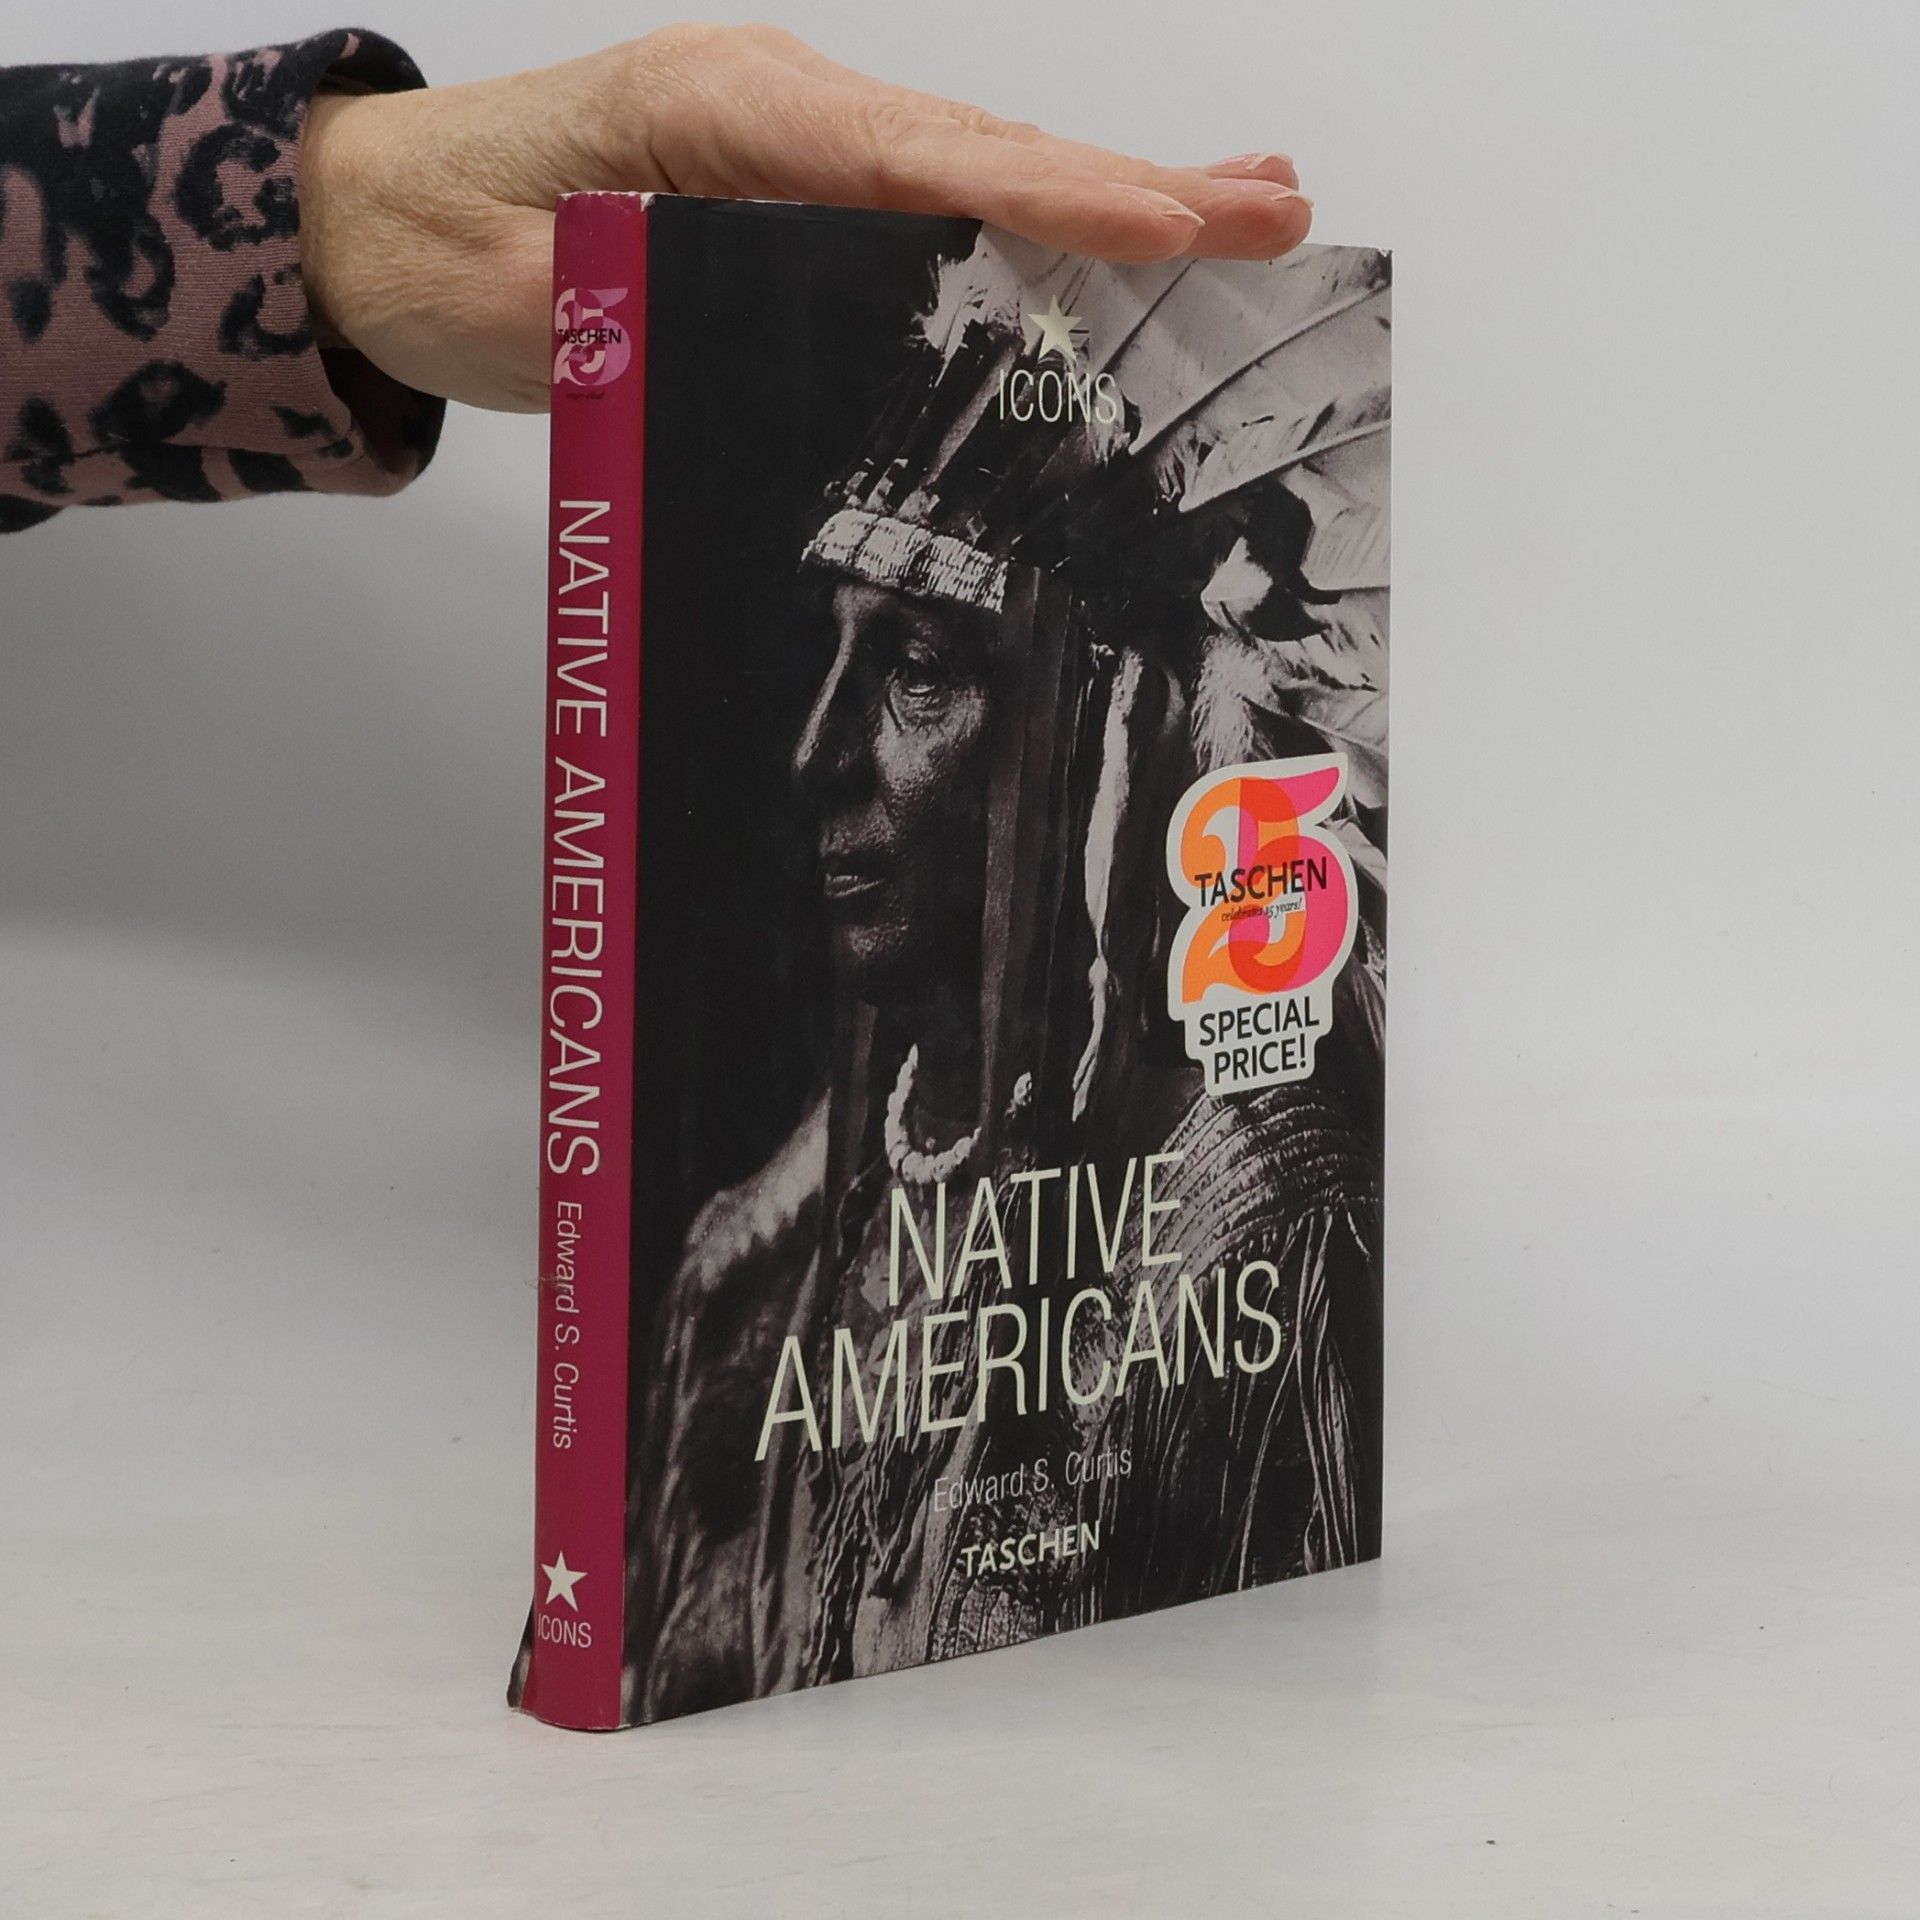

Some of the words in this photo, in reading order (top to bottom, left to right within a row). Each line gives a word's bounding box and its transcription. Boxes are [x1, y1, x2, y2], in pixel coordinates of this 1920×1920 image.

[557, 328, 622, 344] TASCHEN
[1000, 368, 1117, 424] ICONS
[556, 500, 611, 737] NATIVE
[1194, 856, 1328, 908] TASCHEN
[1273, 897, 1303, 919] years!
[547, 756, 606, 1176] AMERICANS
[1198, 996, 1320, 1047] SPECIAL
[1214, 1032, 1308, 1085] PRICE!
[555, 1200, 583, 1314] Edward
[887, 1151, 1185, 1307] NATIVE
[554, 1323, 580, 1350] S.
[754, 1259, 1283, 1462] AMERICANS
[553, 1362, 579, 1450] Curtis
[934, 1462, 1024, 1513] Edward
[1034, 1457, 1056, 1492] S.
[1065, 1443, 1132, 1486] Curtis
[961, 1520, 1101, 1578] TASCHEN
[537, 1613, 592, 1648] ICONS
